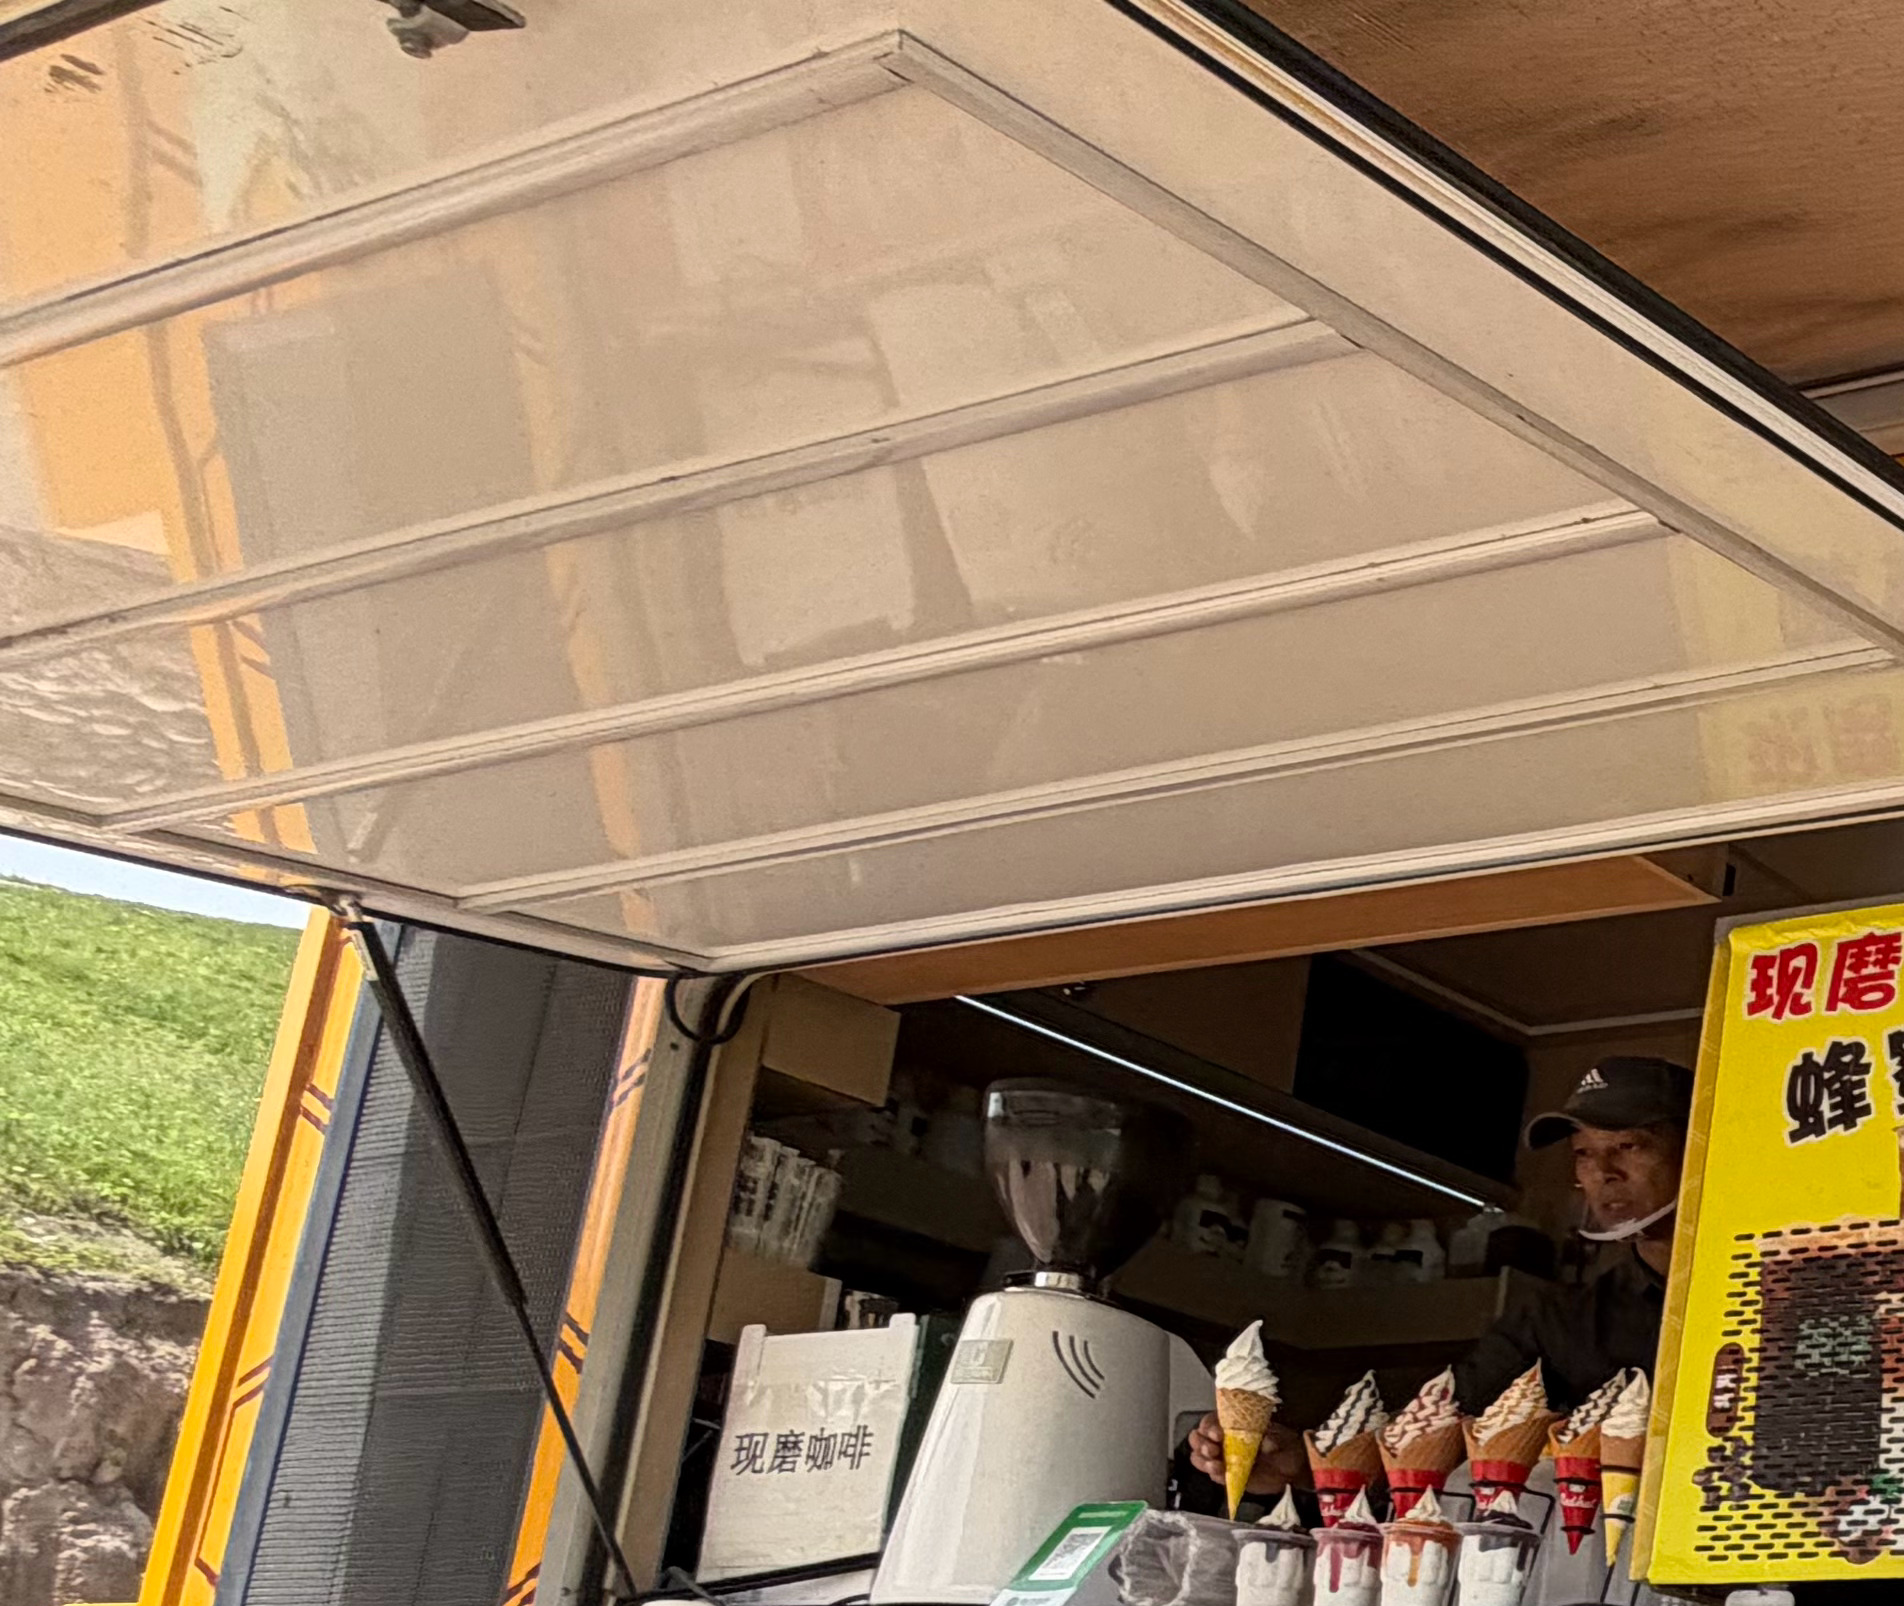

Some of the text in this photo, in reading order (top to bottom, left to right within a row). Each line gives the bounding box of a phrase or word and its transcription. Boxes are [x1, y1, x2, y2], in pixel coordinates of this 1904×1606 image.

[1746, 931, 1904, 1020] 现磨
[730, 1425, 874, 1476] 现磨咖啡
